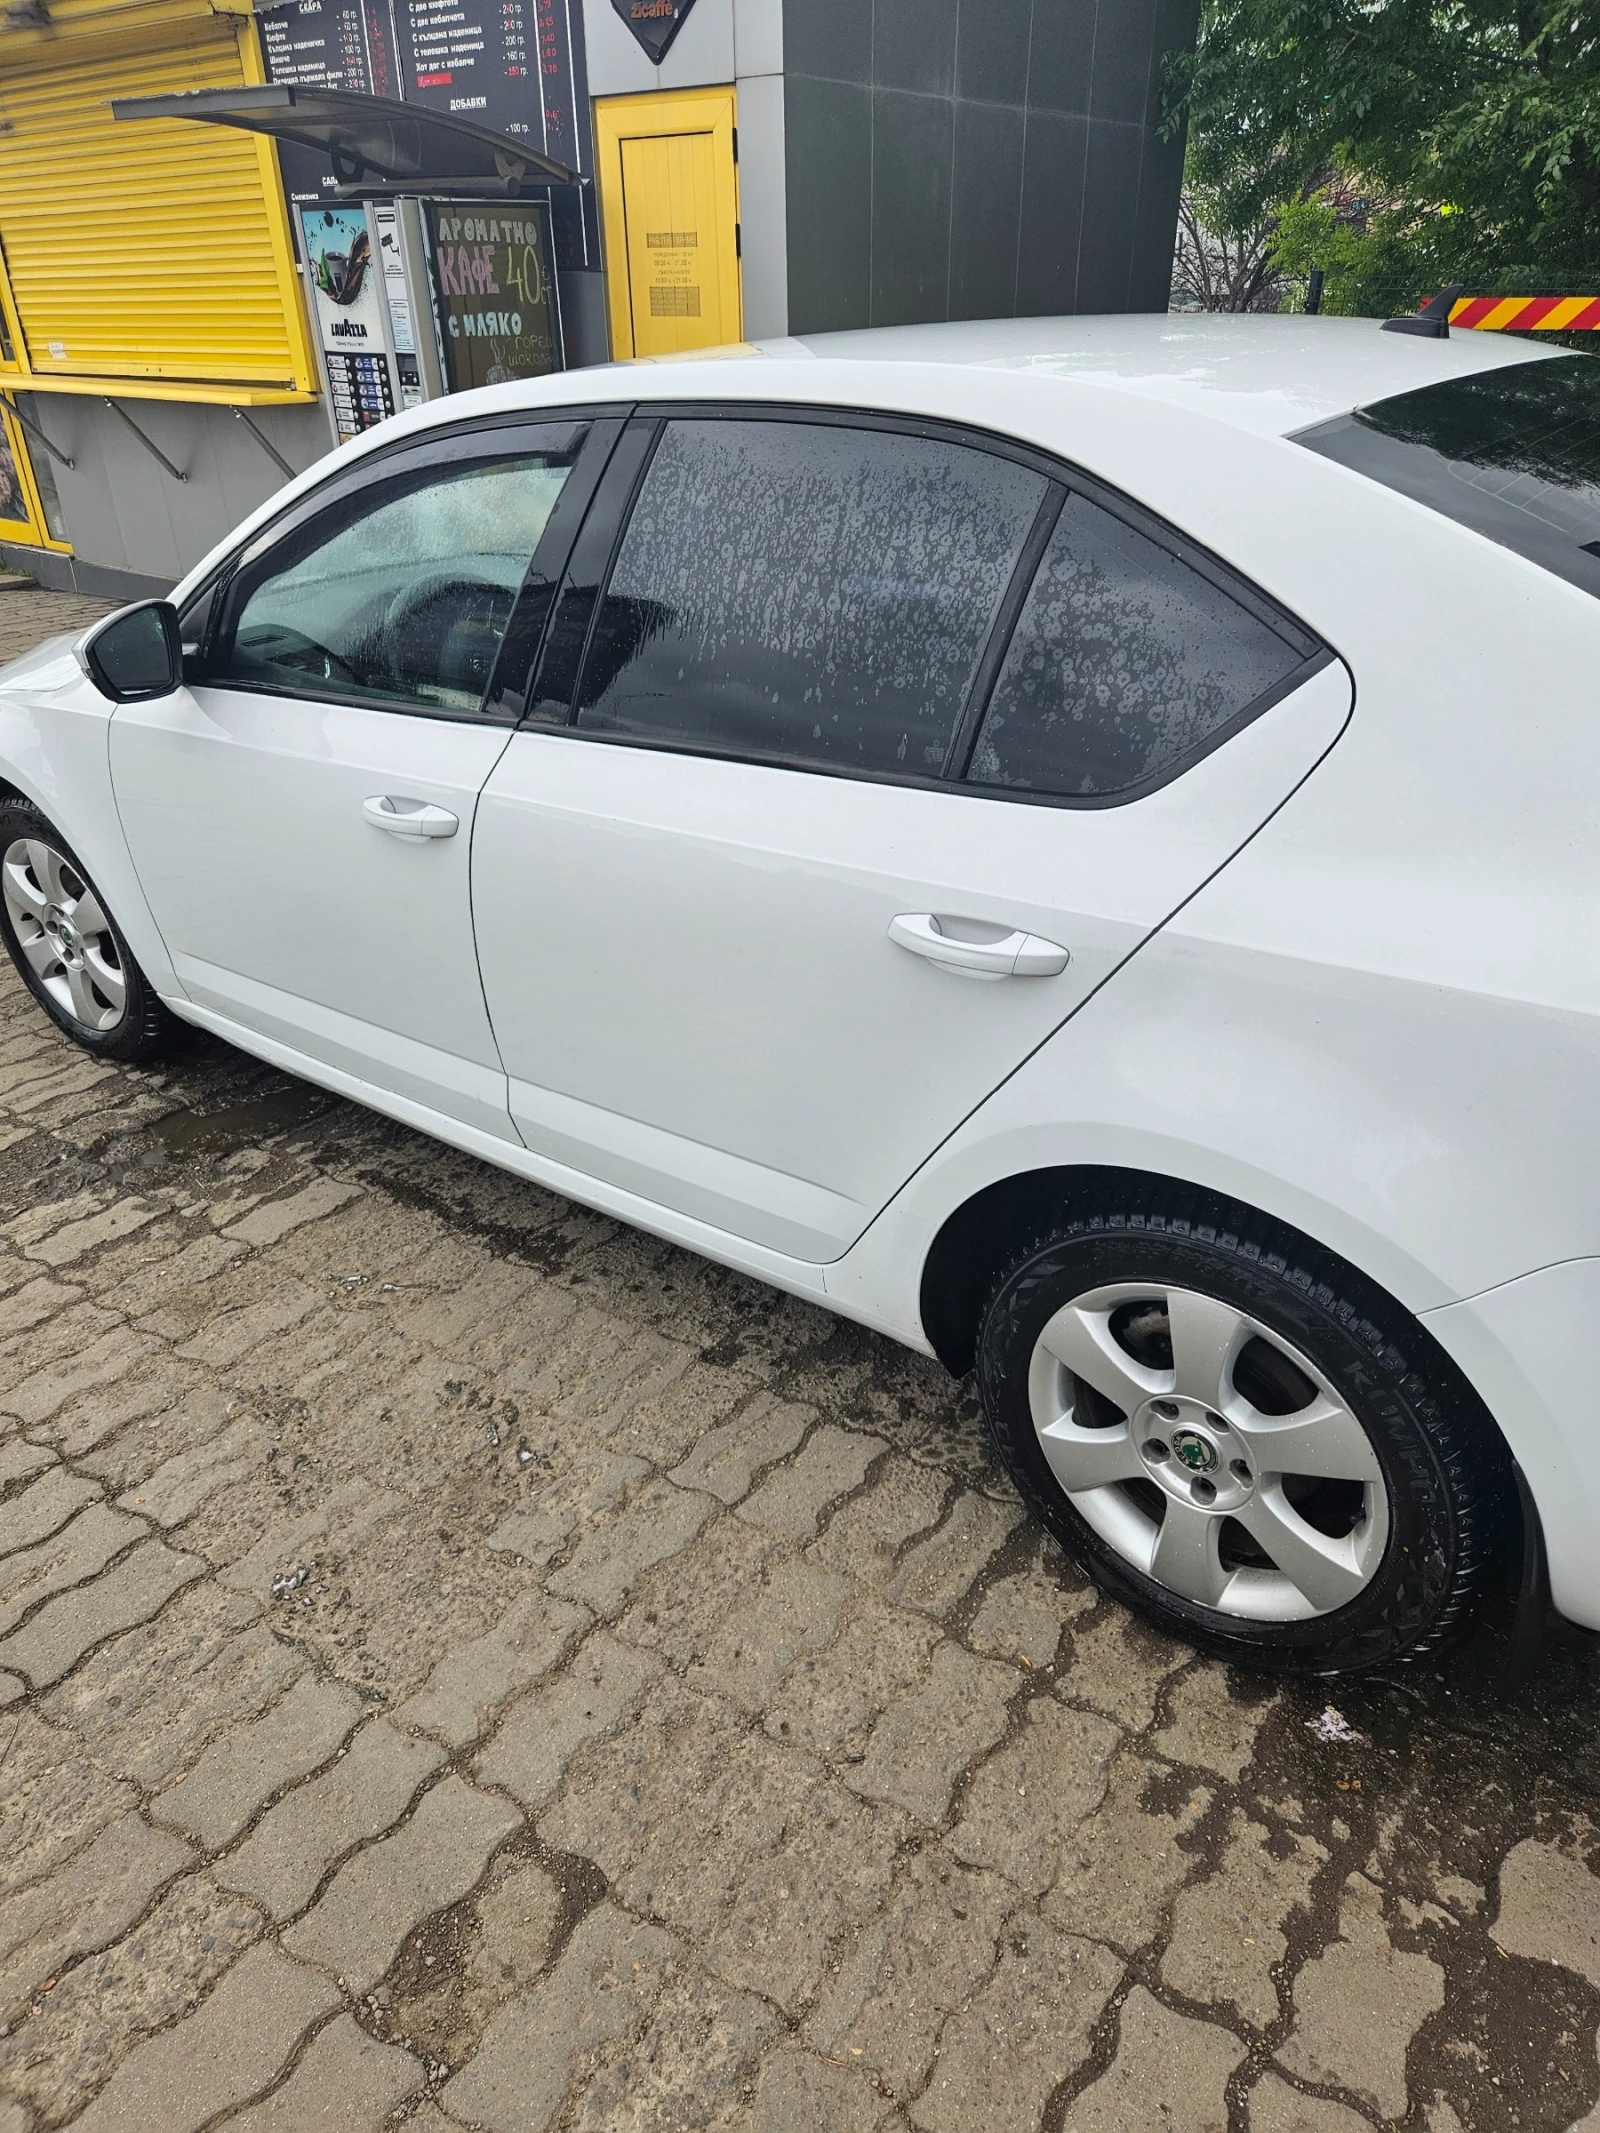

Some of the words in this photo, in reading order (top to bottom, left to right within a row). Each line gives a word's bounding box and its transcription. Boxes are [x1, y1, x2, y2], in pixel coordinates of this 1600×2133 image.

[299, 1, 322, 14] СКАРА
[264, 21, 288, 31] Кебапче
[417, 18, 429, 28] две
[430, 12, 465, 25] кебапчета
[266, 32, 286, 43] Кюфте
[419, 31, 447, 42] кълцана
[448, 26, 482, 39] наденица
[505, 35, 516, 46] 200
[420, 46, 448, 56] телешка
[451, 41, 485, 53] наденица
[269, 55, 290, 65] Шишче
[416, 62, 427, 72] Хот
[429, 61, 440, 72] дог
[447, 57, 475, 68] кебапче
[271, 65, 297, 75] Телешка
[297, 61, 326, 73] наденица
[326, 70, 343, 81] филе
[450, 97, 487, 111] ДОБАВКИ
[510, 123, 521, 133] 100
[439, 217, 537, 246] АРОМАТНО
[436, 245, 500, 296] КАФЕ
[506, 245, 541, 305] 40
[331, 318, 368, 337] LAVAZZA
[463, 312, 522, 337] МЛЯКО
[1344, 1361, 1436, 1503] KUMHO
